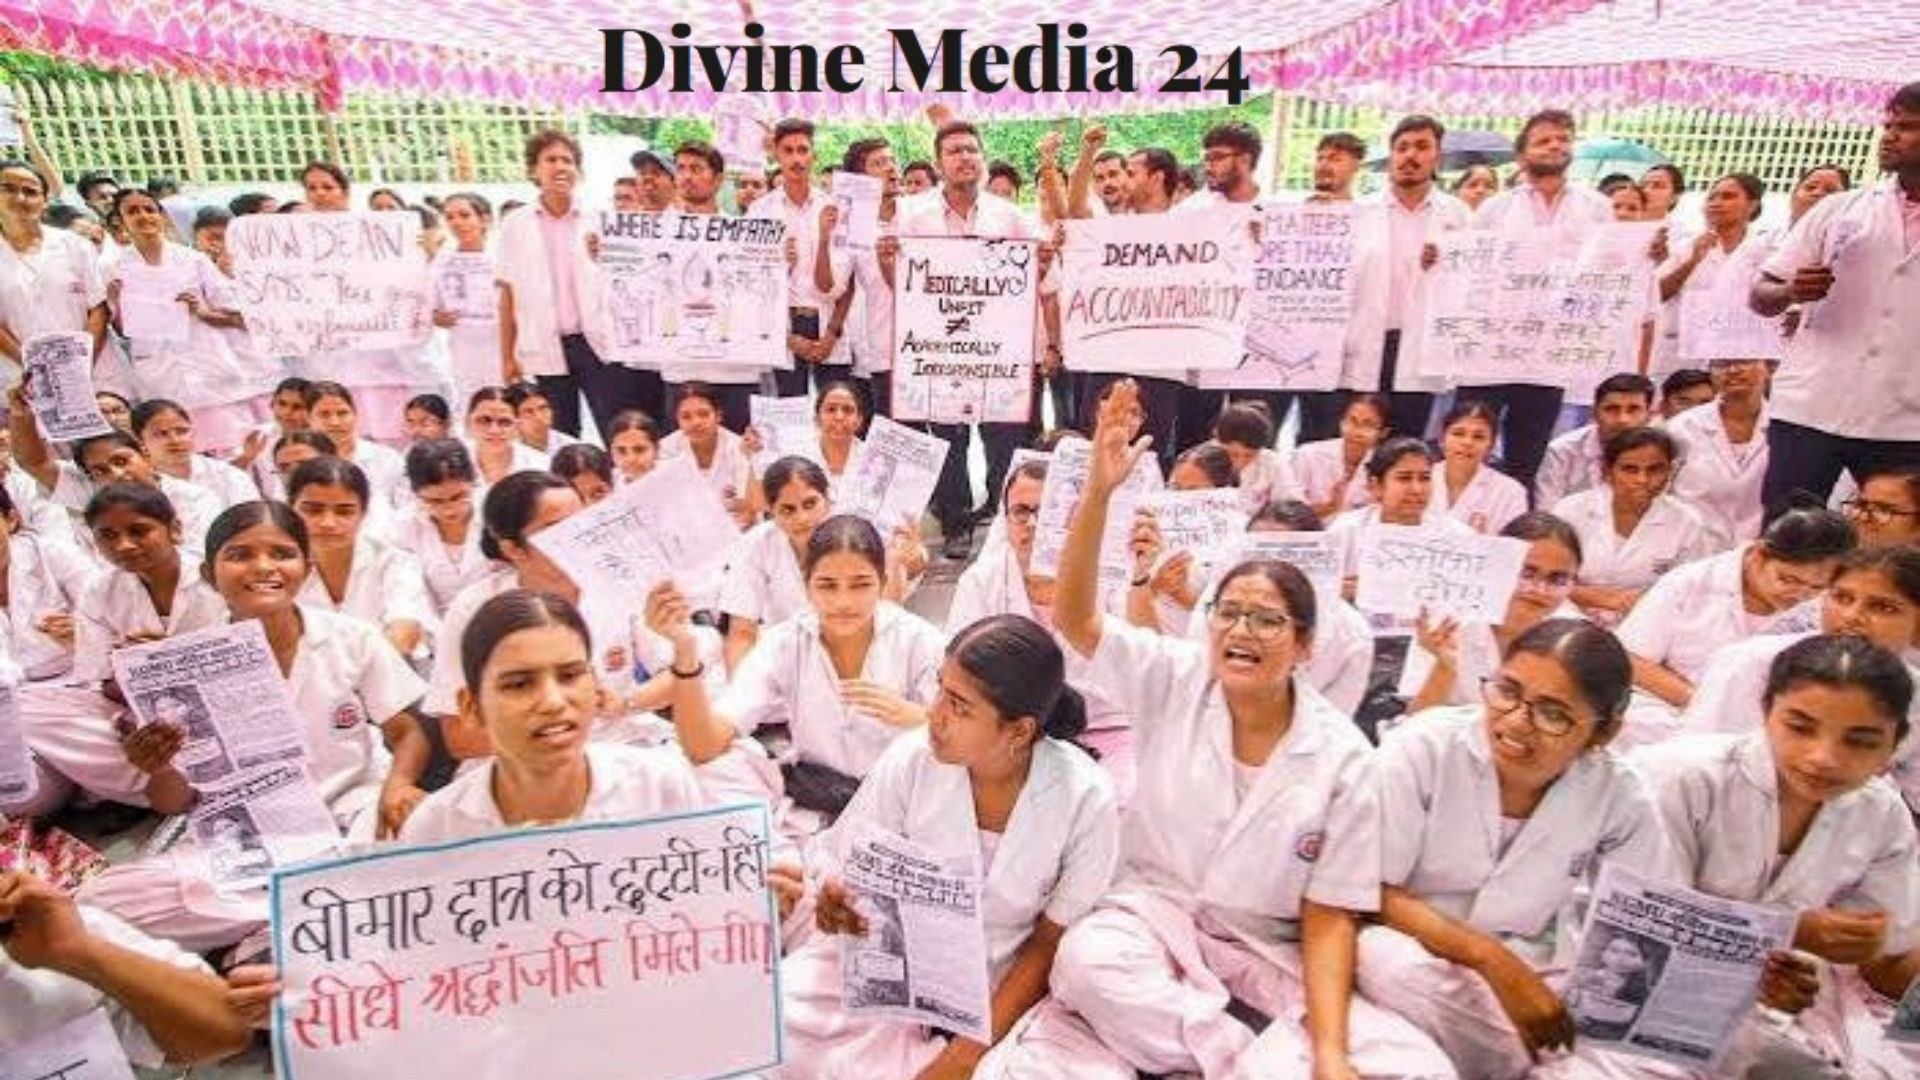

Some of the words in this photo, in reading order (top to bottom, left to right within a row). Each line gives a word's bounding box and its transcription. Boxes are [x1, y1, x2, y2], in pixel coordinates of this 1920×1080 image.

[600, 211, 661, 239] WHERE
[674, 215, 700, 241] IS
[706, 216, 786, 245] EMPATHY
[1265, 213, 1351, 236] MATTERS
[1102, 241, 1219, 267] DEMAND
[1294, 240, 1352, 264] THAN
[906, 258, 1007, 296] MEDICALLY
[1253, 267, 1346, 290] ENDANCE
[938, 297, 985, 316] UNFIT
[1066, 281, 1247, 324] ACCOUNTABILITY
[292, 886, 437, 961] बीमार
[448, 870, 534, 944] छात्र
[541, 848, 602, 916] को
[294, 961, 414, 1049] सीधे
